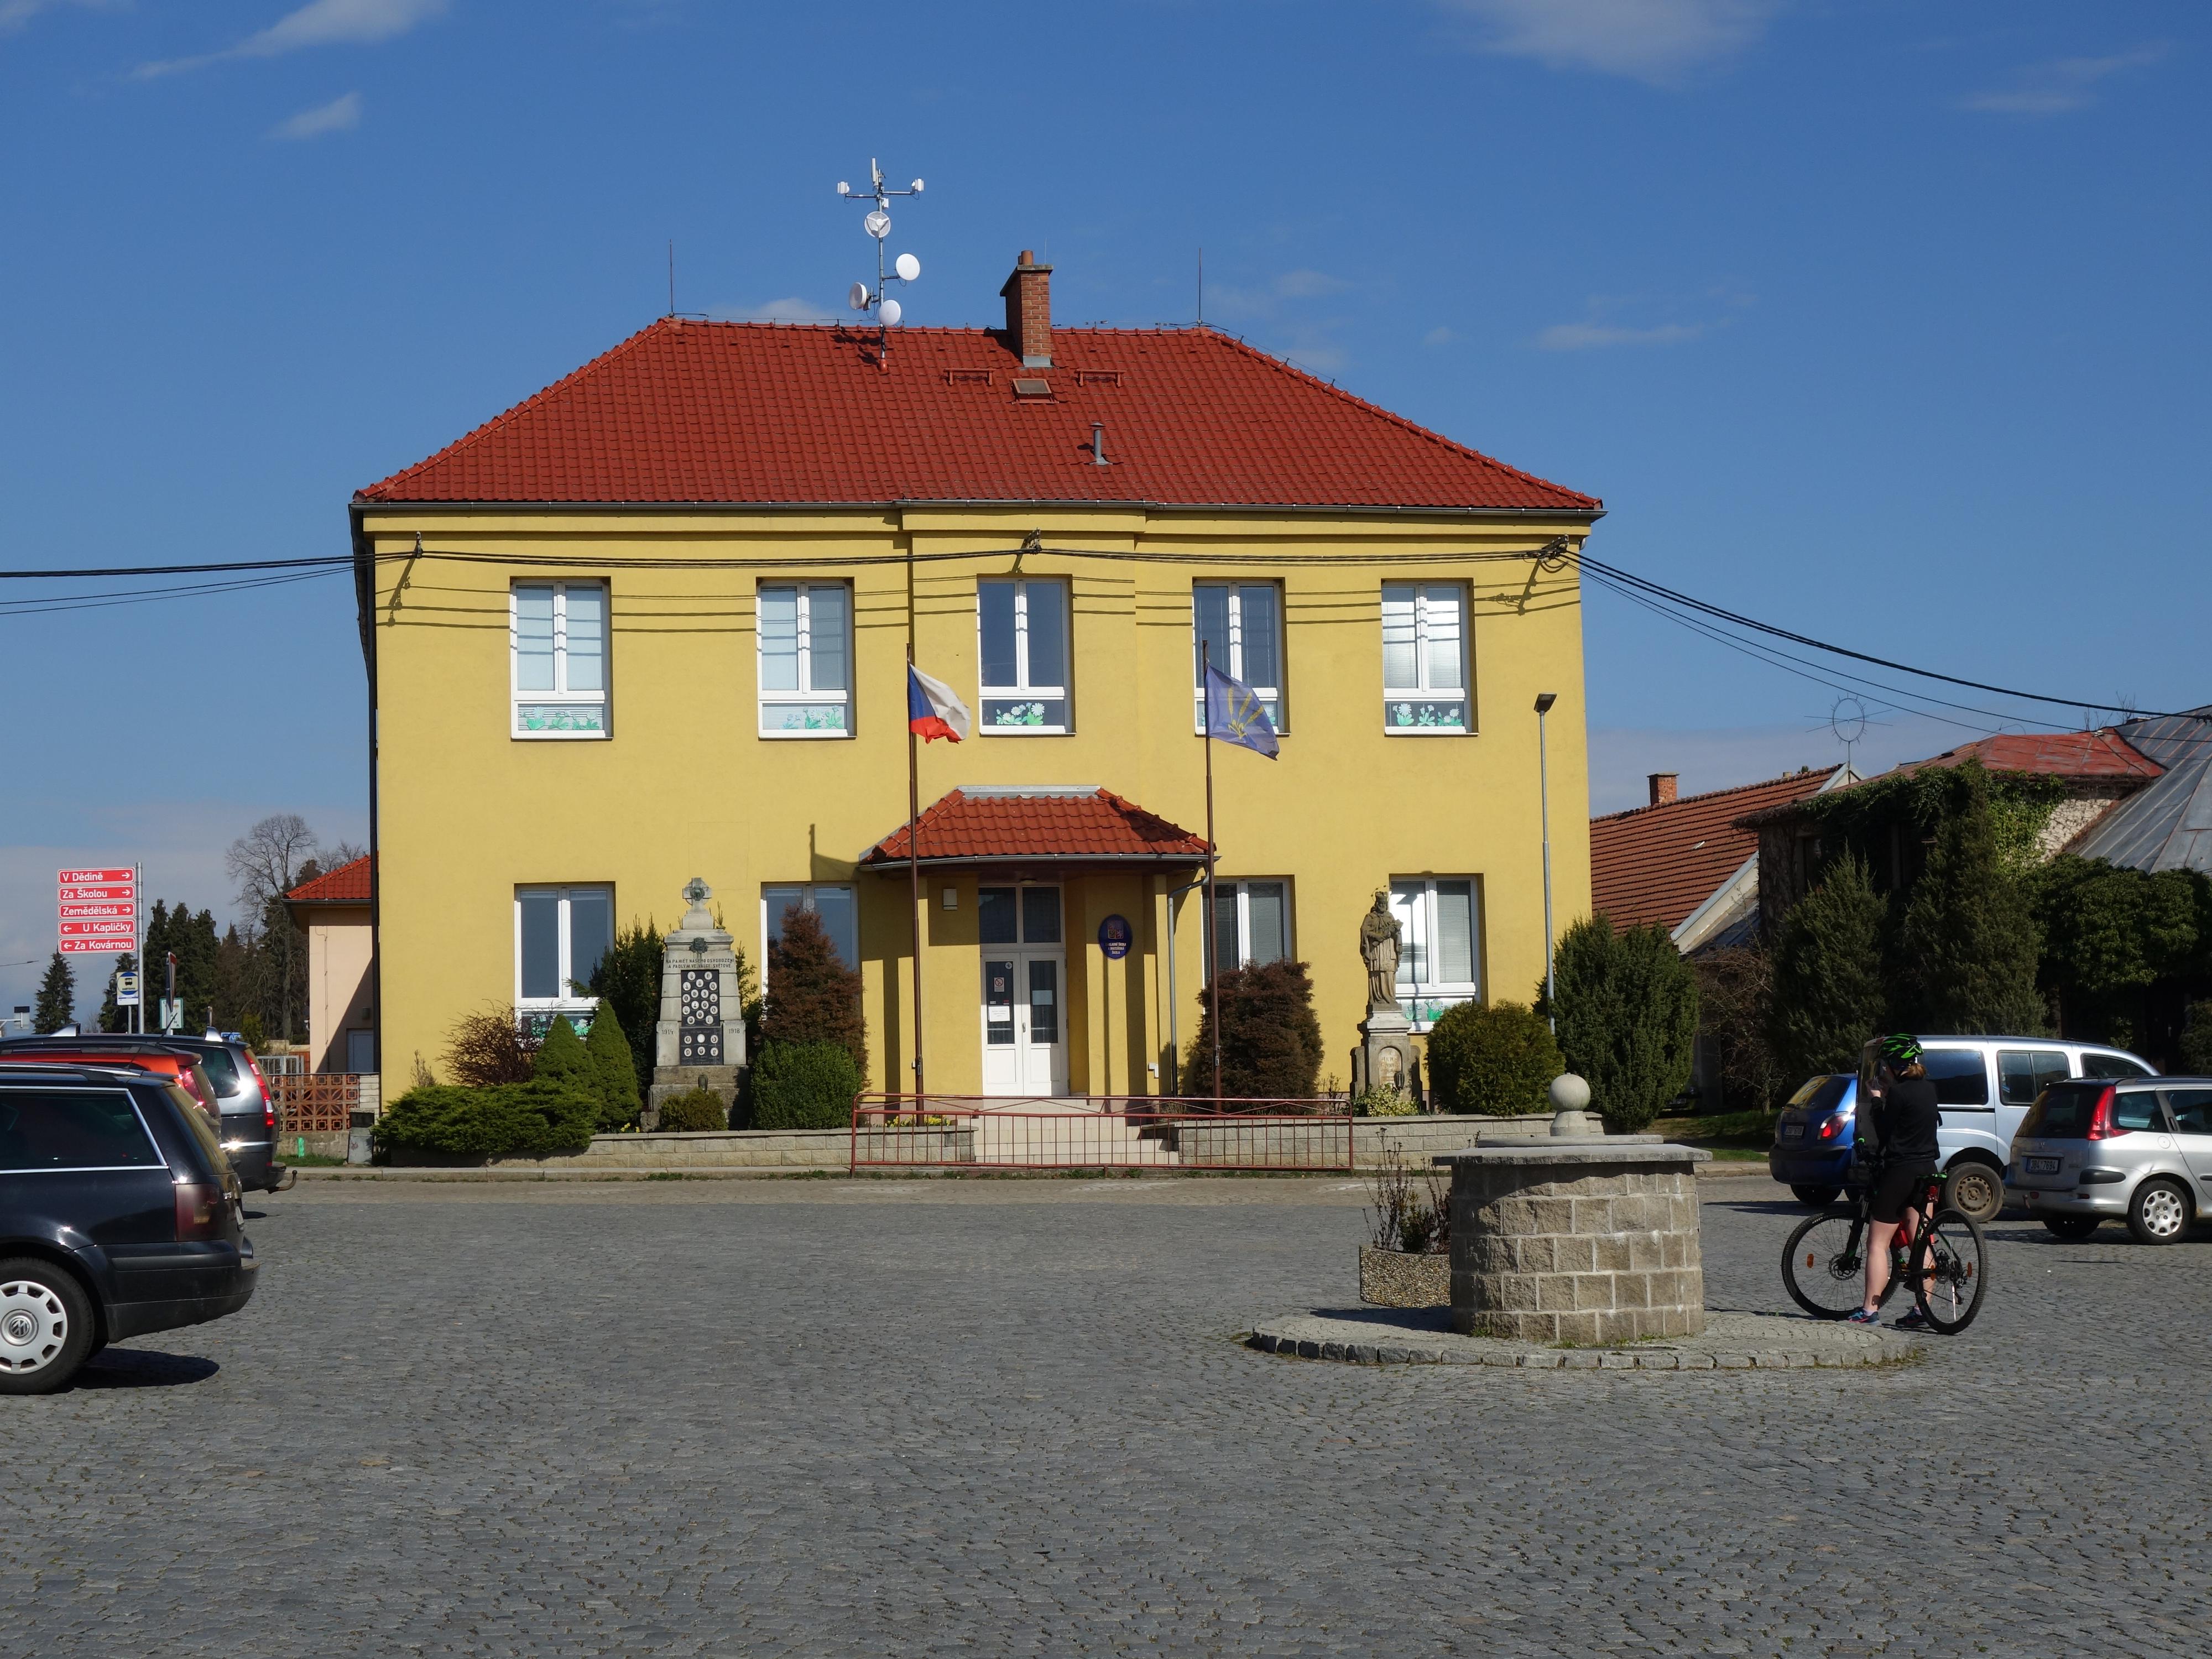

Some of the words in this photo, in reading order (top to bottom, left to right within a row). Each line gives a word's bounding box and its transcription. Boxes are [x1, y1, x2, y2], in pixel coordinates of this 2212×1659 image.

[62, 873, 69, 881] V
[72, 872, 103, 881] Dědině
[62, 890, 74, 899] Za
[77, 888, 107, 898] Školou
[62, 906, 117, 916] Zemědělská
[83, 924, 90, 932] U
[93, 922, 131, 933] Kapličky
[74, 941, 86, 950] Za
[89, 941, 132, 950] Kovárnou
